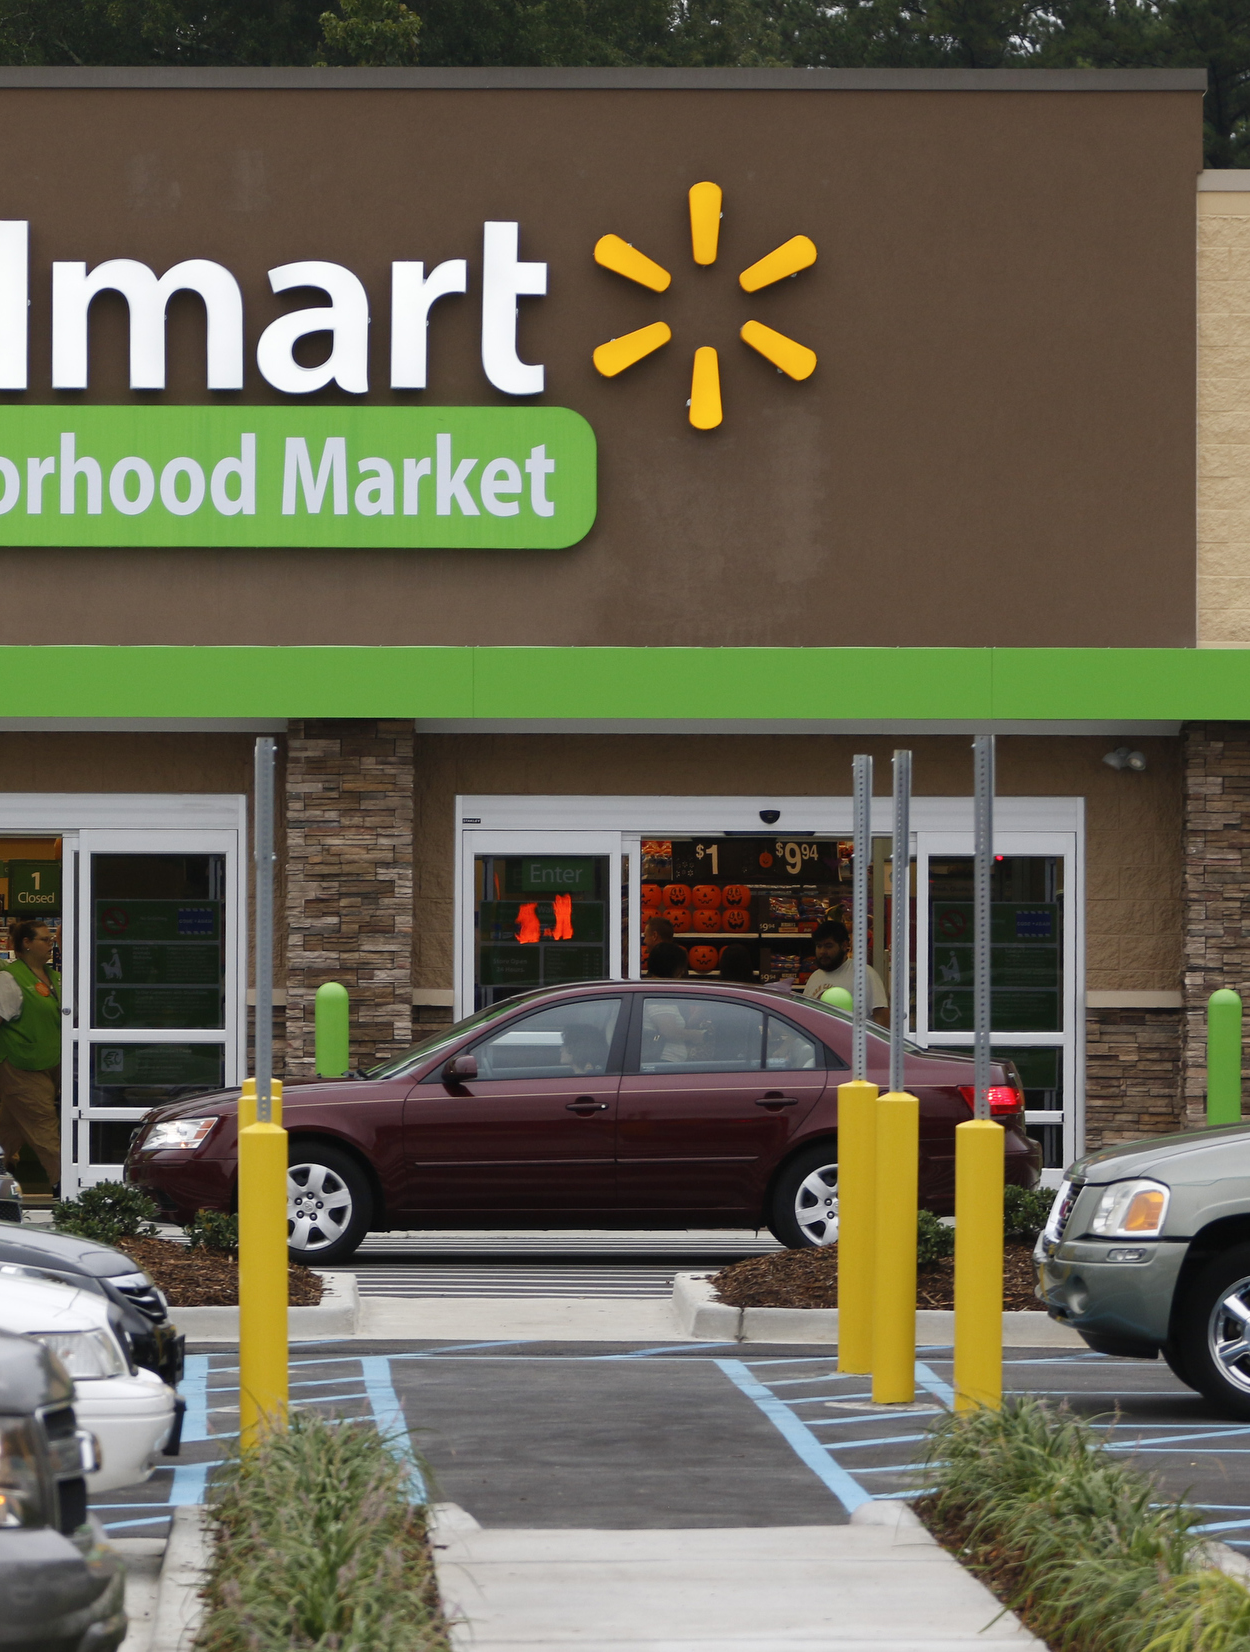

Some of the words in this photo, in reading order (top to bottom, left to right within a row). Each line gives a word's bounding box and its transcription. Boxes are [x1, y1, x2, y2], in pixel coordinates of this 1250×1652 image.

[281, 434, 554, 518] Market
[696, 843, 719, 875] $1
[776, 842, 819, 875] $994
[31, 872, 40, 890] 1
[530, 864, 583, 883] Enter
[17, 891, 55, 903] Closed
